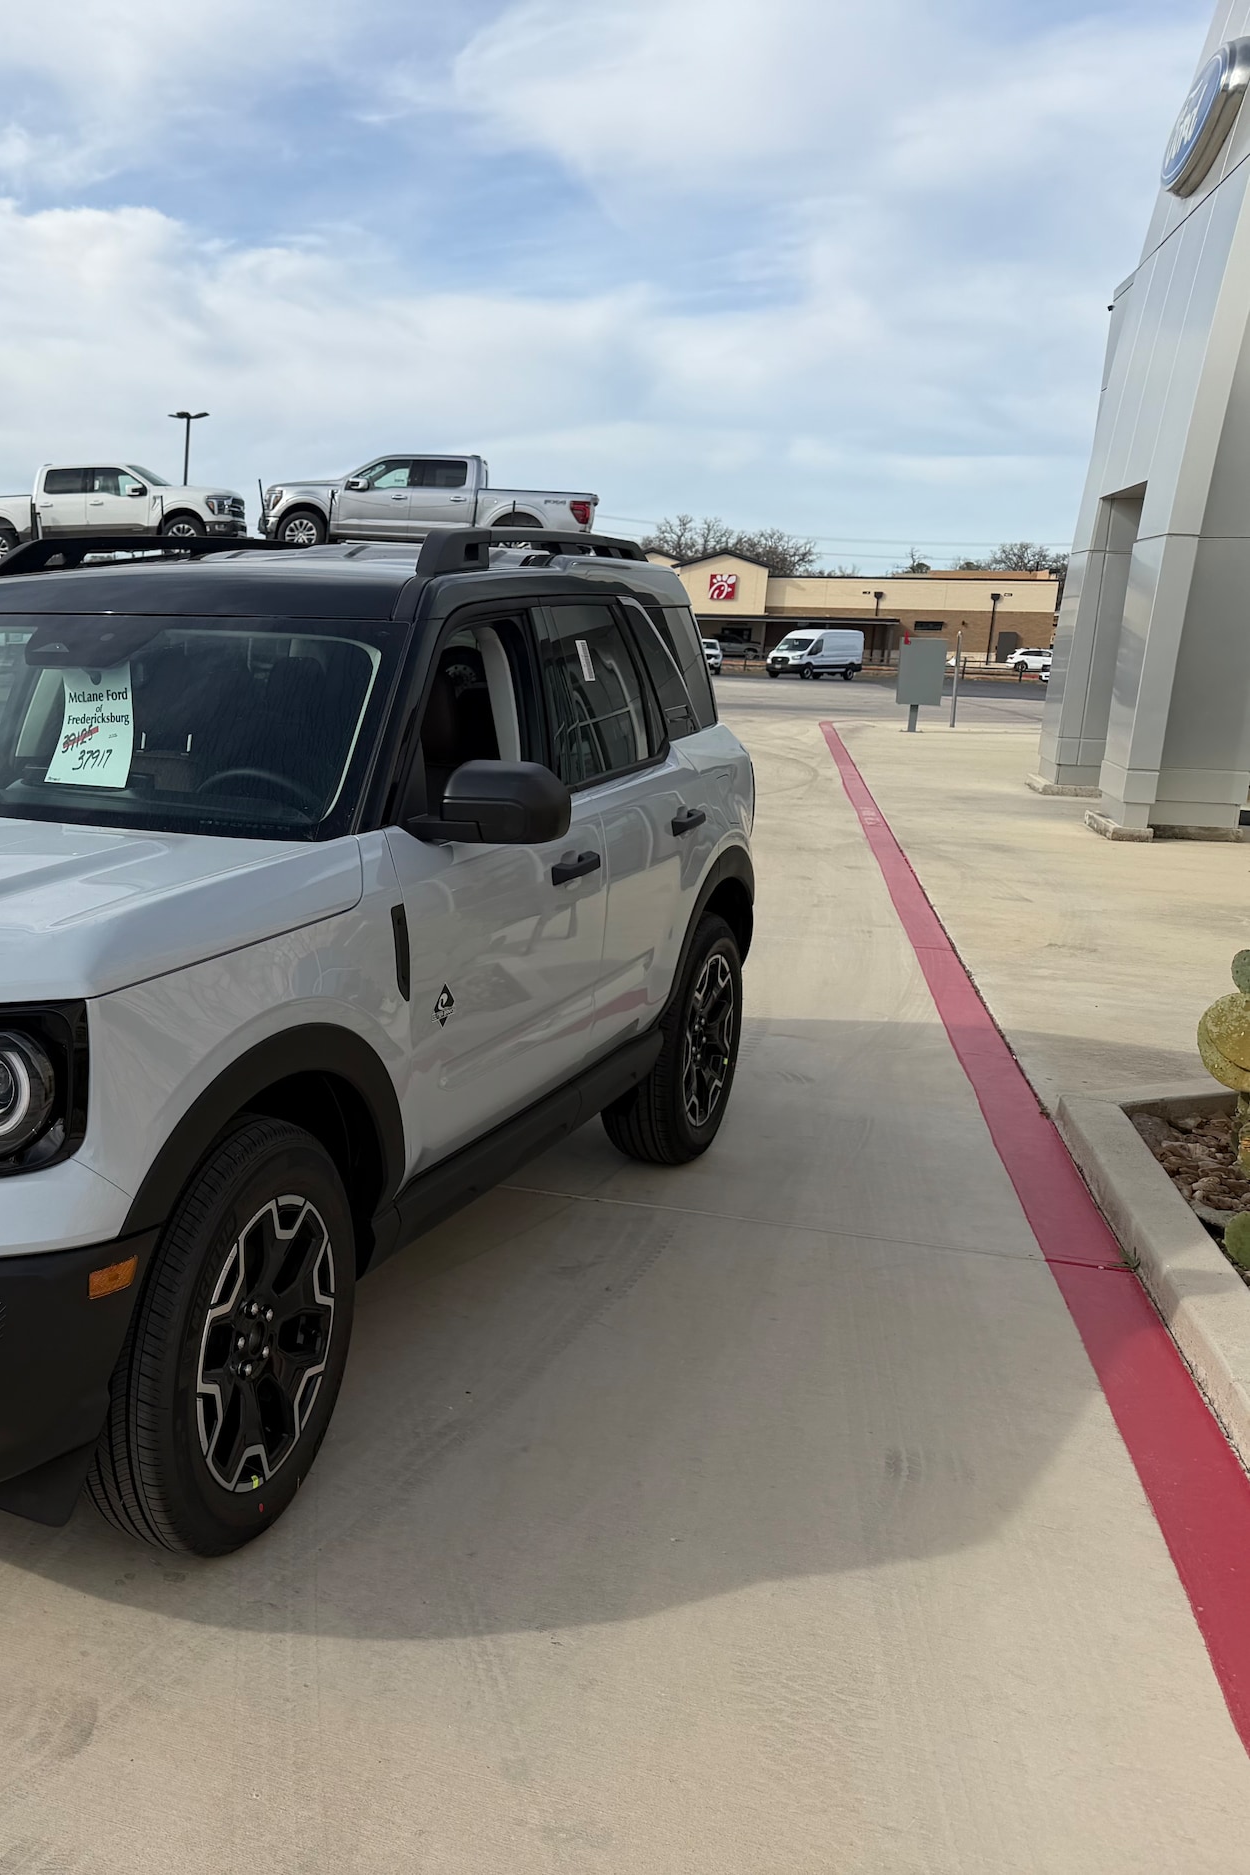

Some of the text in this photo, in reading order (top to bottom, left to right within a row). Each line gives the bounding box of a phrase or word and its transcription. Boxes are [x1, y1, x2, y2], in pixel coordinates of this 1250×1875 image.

[68, 687, 128, 703] McLane Ford
[95, 704, 103, 713] of
[67, 712, 130, 726] Fredericksburg
[72, 748, 113, 771] 37917
